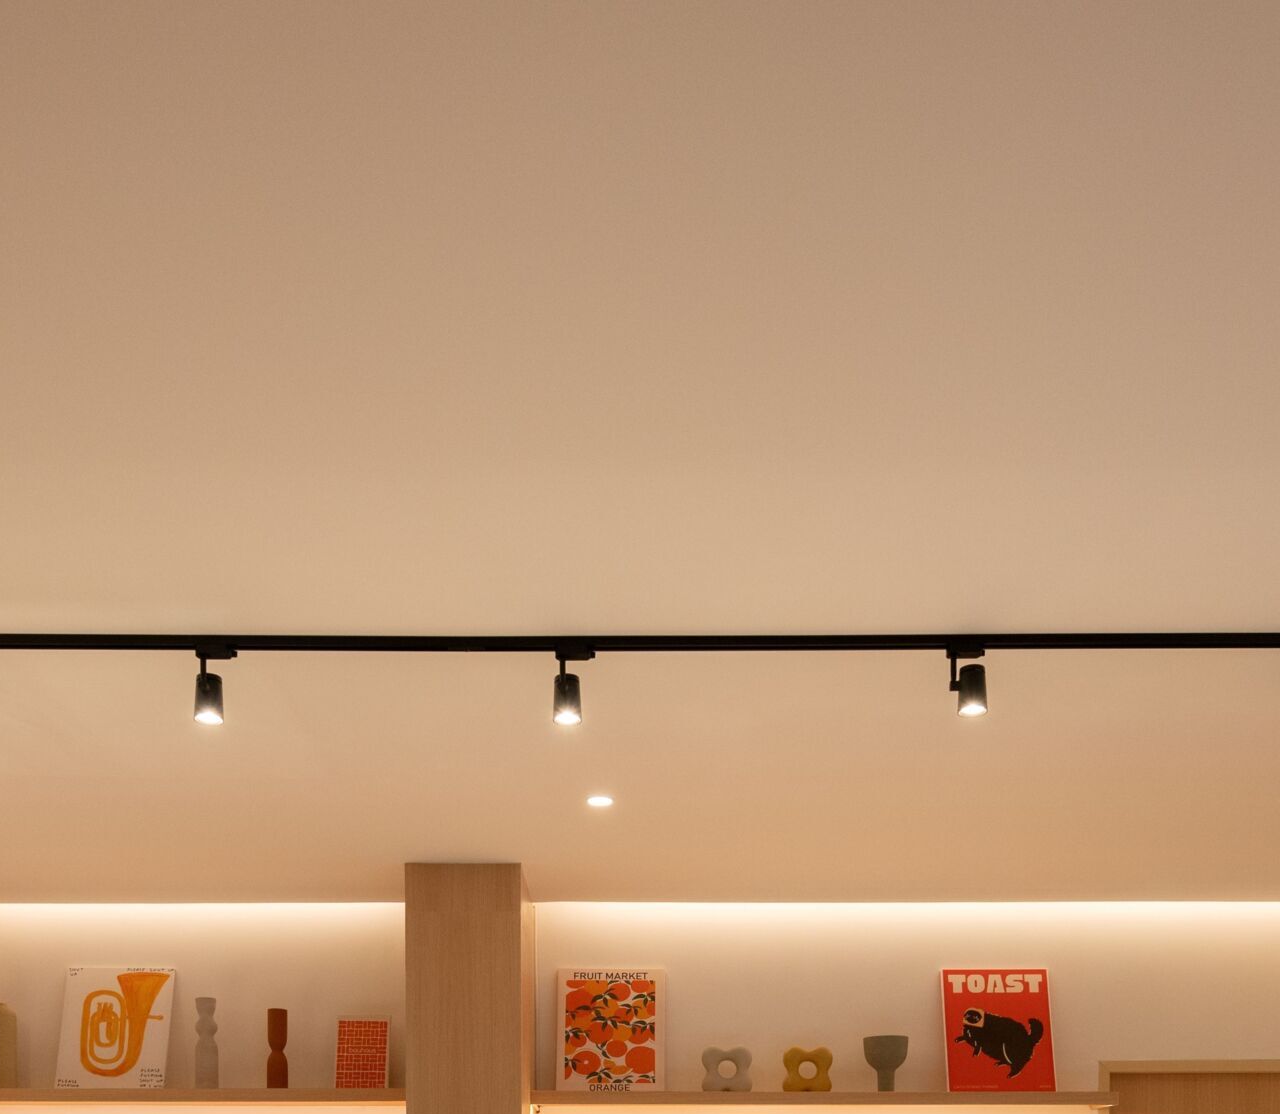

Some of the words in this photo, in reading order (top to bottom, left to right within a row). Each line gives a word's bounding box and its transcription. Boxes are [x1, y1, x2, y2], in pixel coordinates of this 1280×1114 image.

[573, 972, 603, 980] FRUIT
[605, 972, 648, 980] MARKET
[947, 974, 1043, 994] TOAST
[589, 1084, 631, 1092] ORANGE
